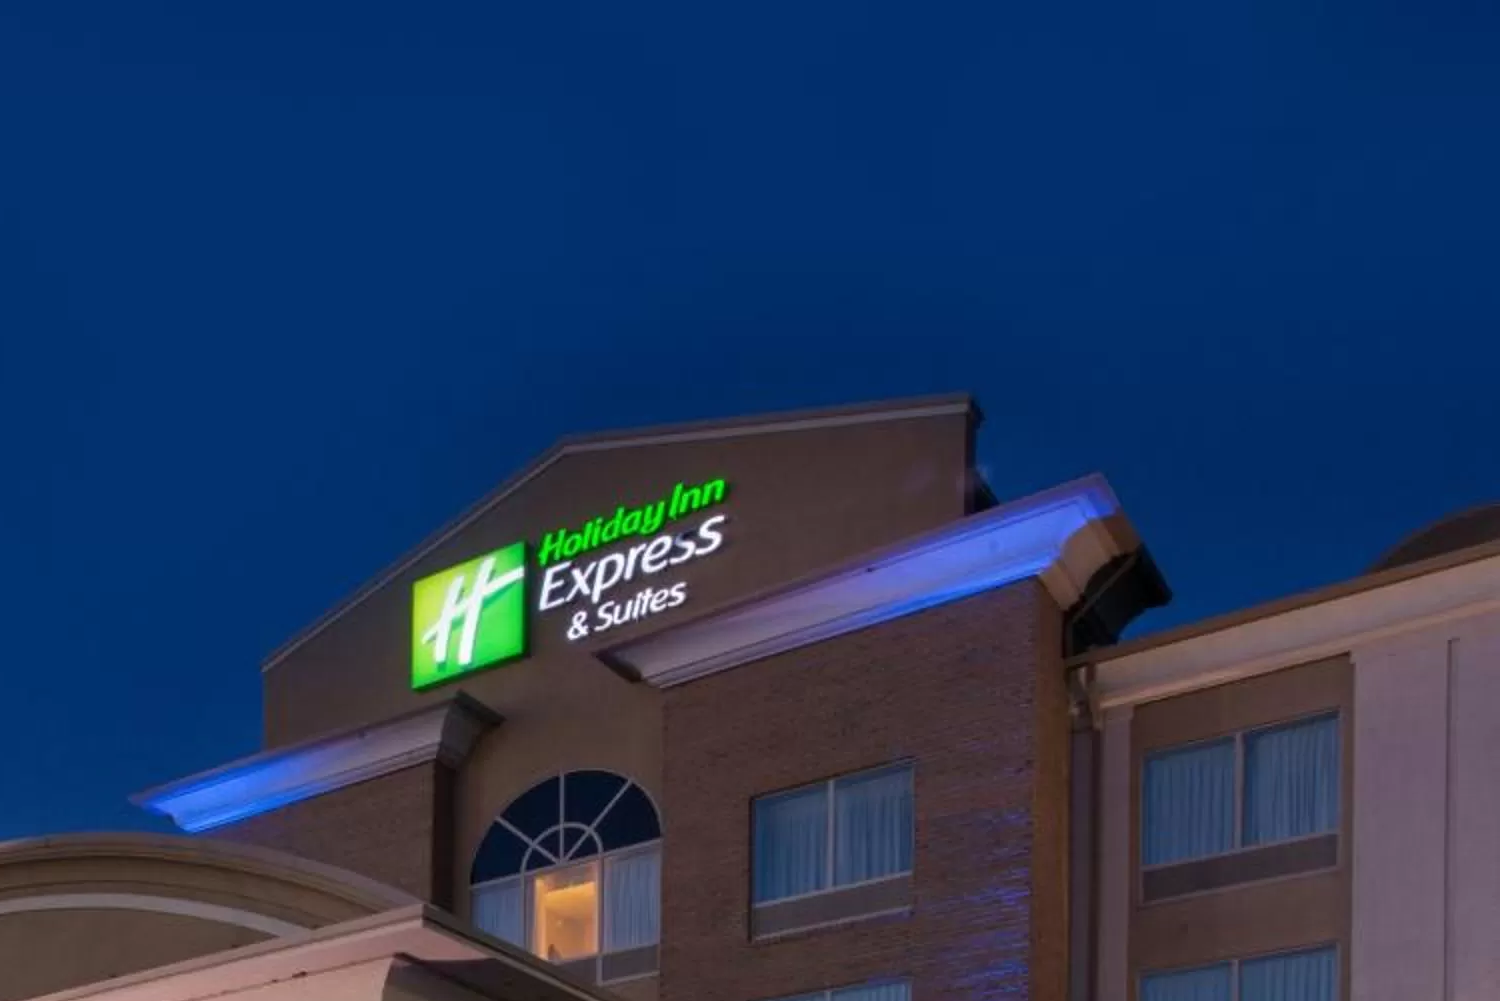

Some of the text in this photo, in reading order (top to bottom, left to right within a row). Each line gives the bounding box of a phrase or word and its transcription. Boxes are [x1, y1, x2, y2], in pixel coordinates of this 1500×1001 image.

[538, 478, 726, 567] Holiday Inn
[538, 513, 727, 612] Express
[566, 581, 687, 641] & Suites
